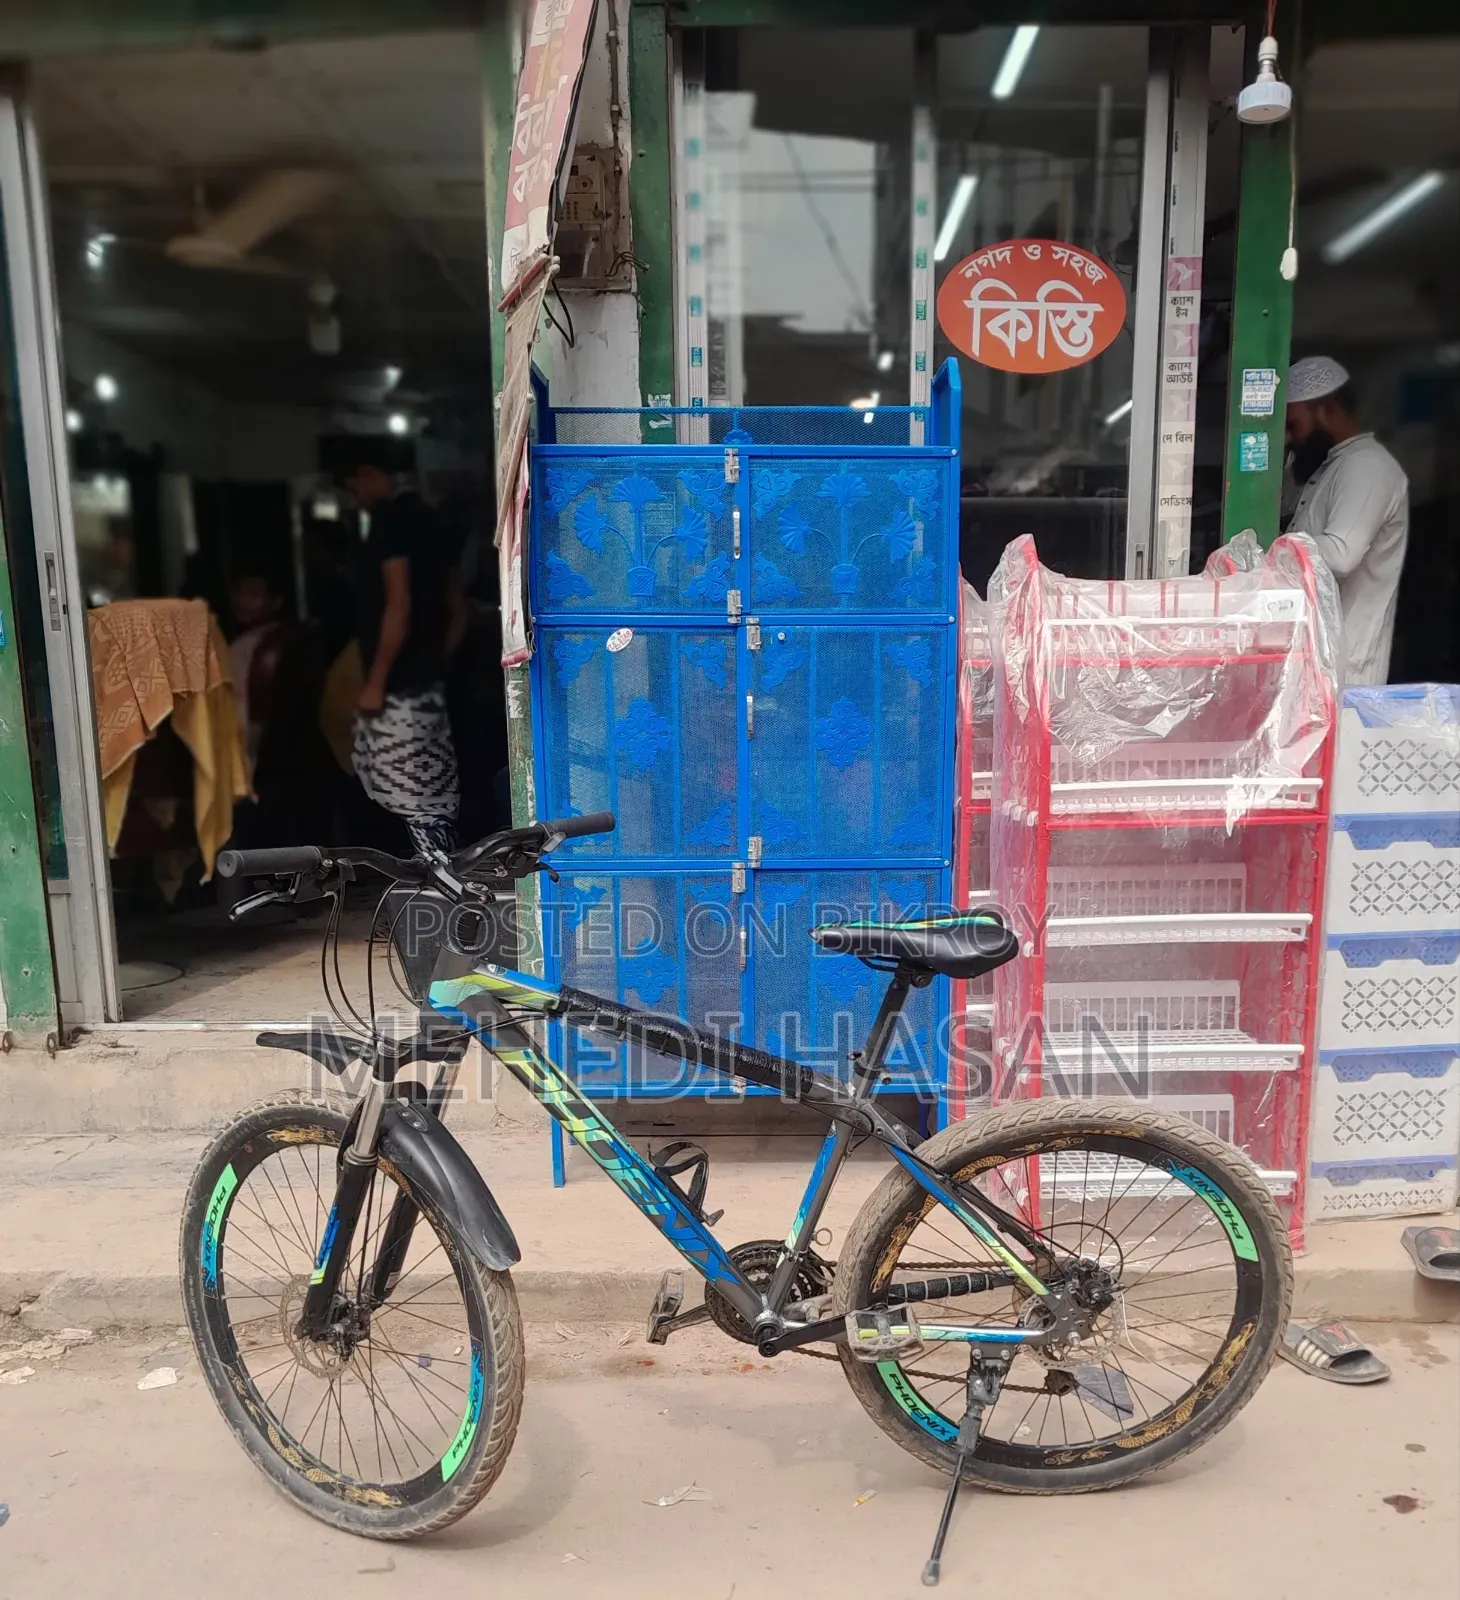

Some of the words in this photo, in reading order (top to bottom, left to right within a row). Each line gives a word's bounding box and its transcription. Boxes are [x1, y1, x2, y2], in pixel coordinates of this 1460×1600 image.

[959, 245, 1014, 278] নগদ
[1021, 244, 1041, 260] ও
[1051, 245, 1107, 286] সহজ
[963, 278, 1105, 359] কিস্তি
[1170, 296, 1194, 306] ক্যাশ
[1175, 307, 1189, 318] ইন
[1166, 372, 1194, 383] আউট
[1168, 362, 1192, 372] ক্যাশ
[1162, 434, 1173, 444] পে
[1175, 431, 1193, 444] বিল
[496, 1048, 740, 1285] PHOENIX
[205, 1185, 227, 1267] PHOENIX
[1181, 1171, 1244, 1240] PHOENIX
[452, 1371, 480, 1459] PHOENIX
[889, 1373, 952, 1435] PHOENIX
